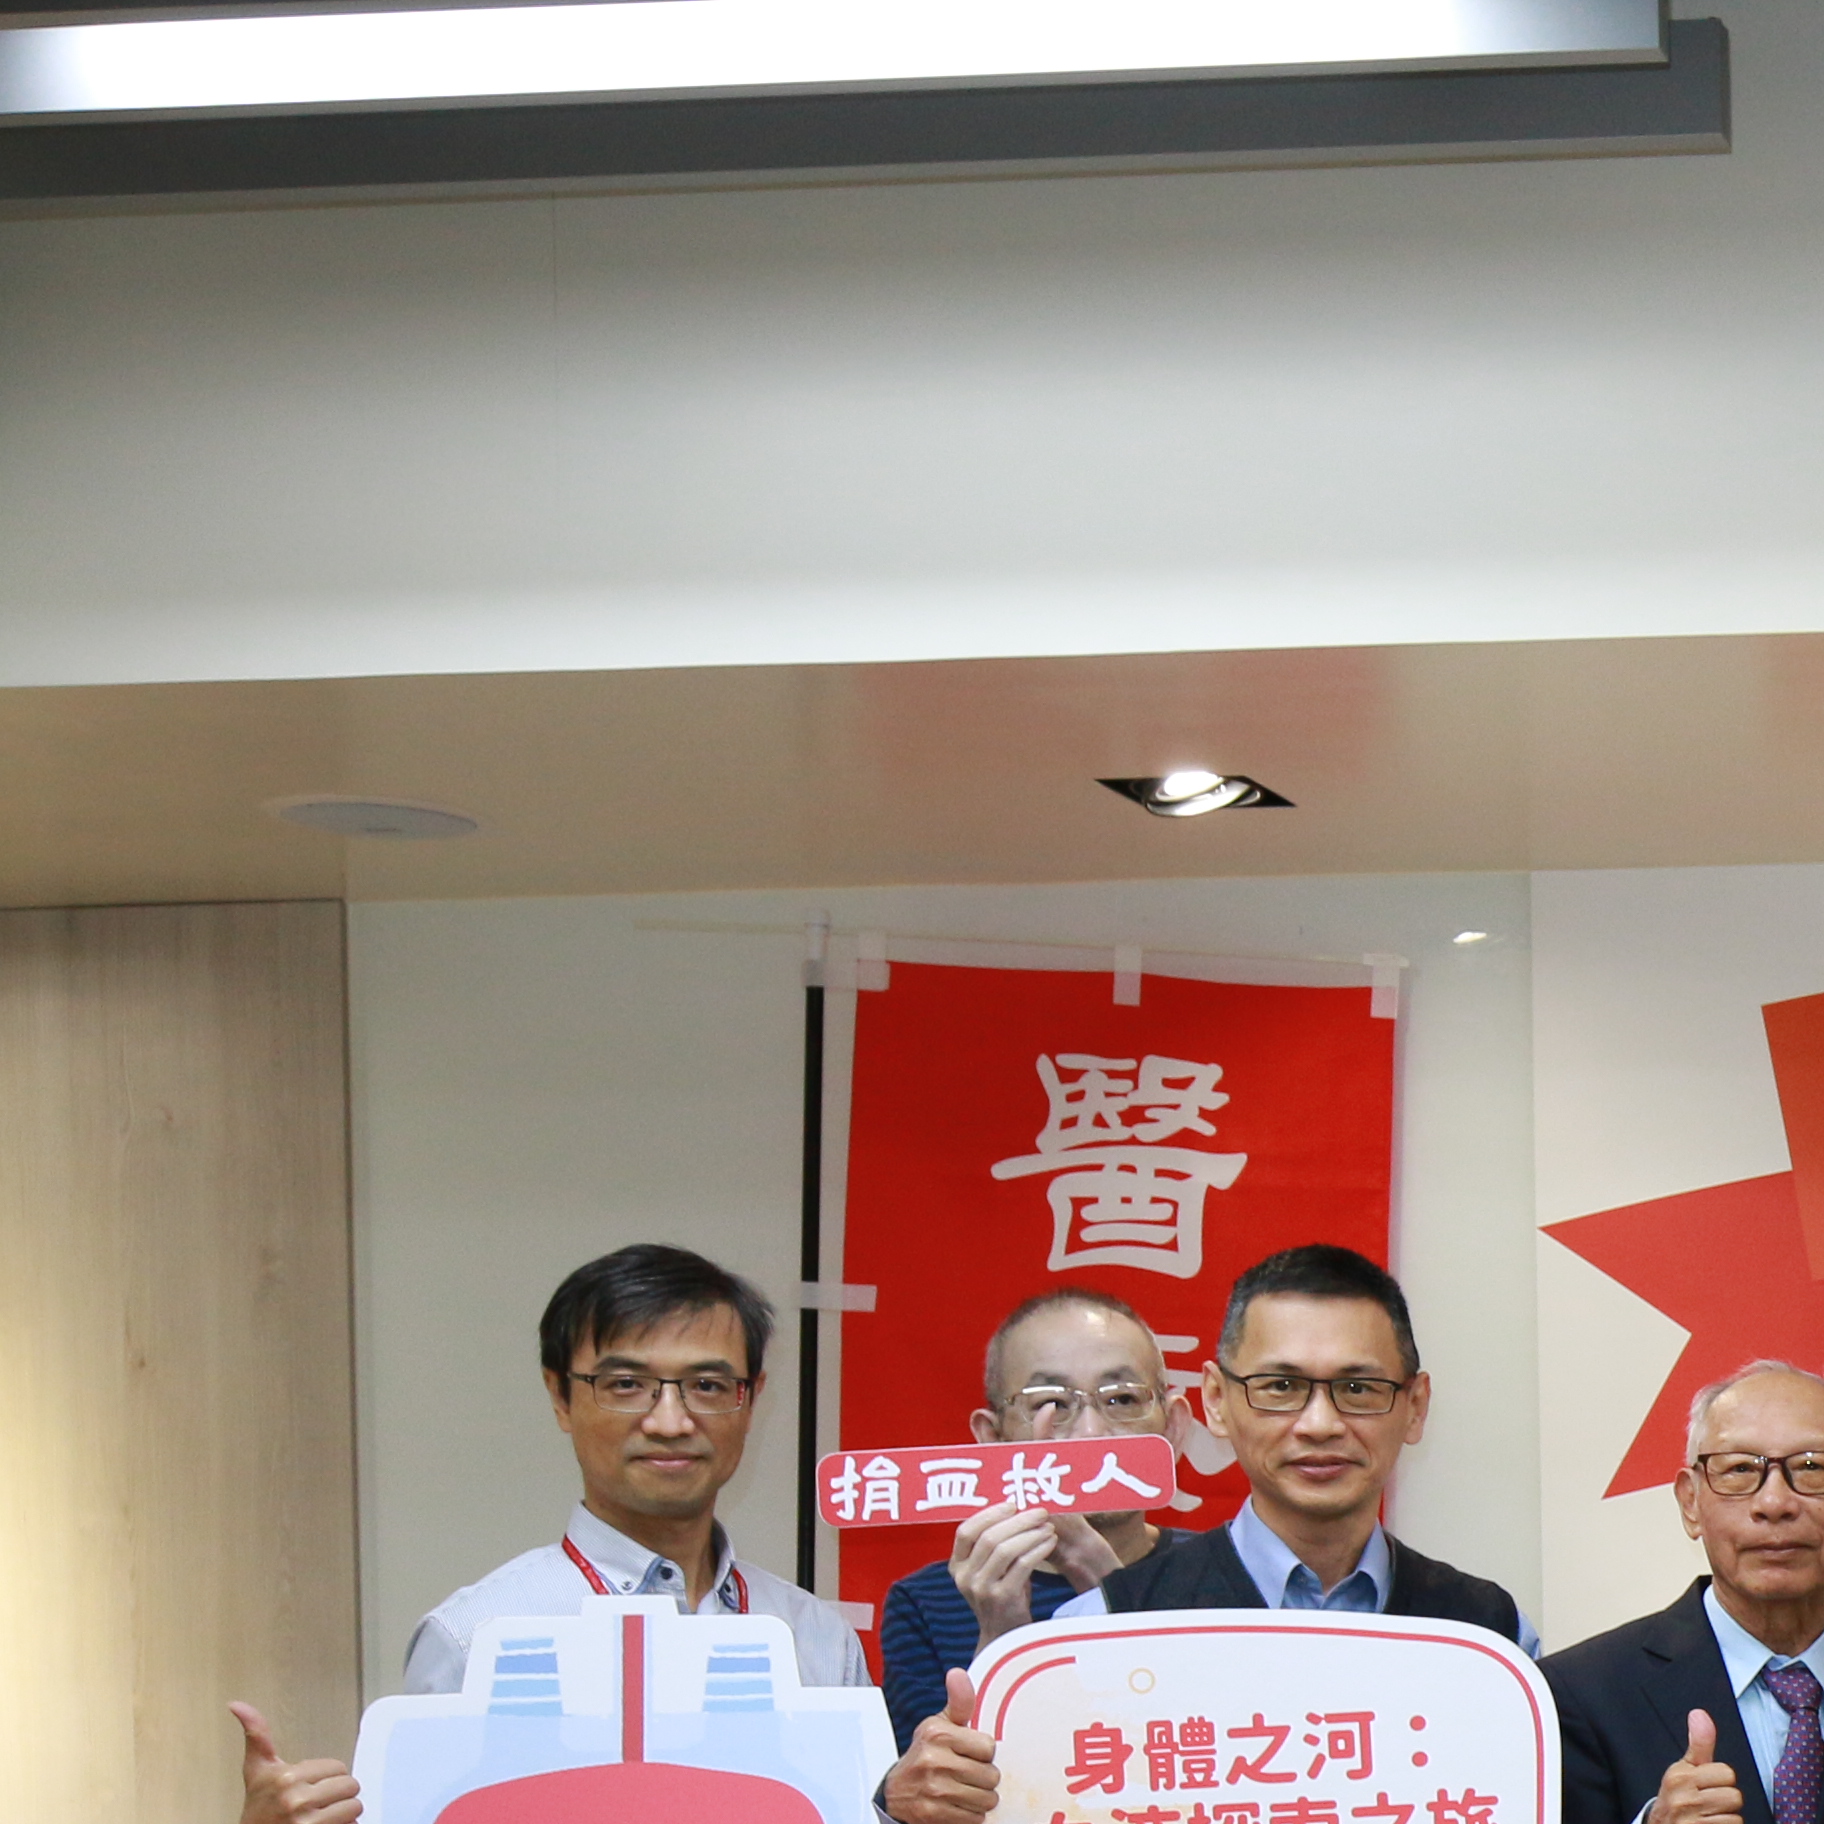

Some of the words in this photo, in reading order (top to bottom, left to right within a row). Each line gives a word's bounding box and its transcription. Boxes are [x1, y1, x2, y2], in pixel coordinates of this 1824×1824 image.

[830, 1453, 1162, 1521] 捐血救人
[1064, 1711, 1428, 1796] 身體之河：
